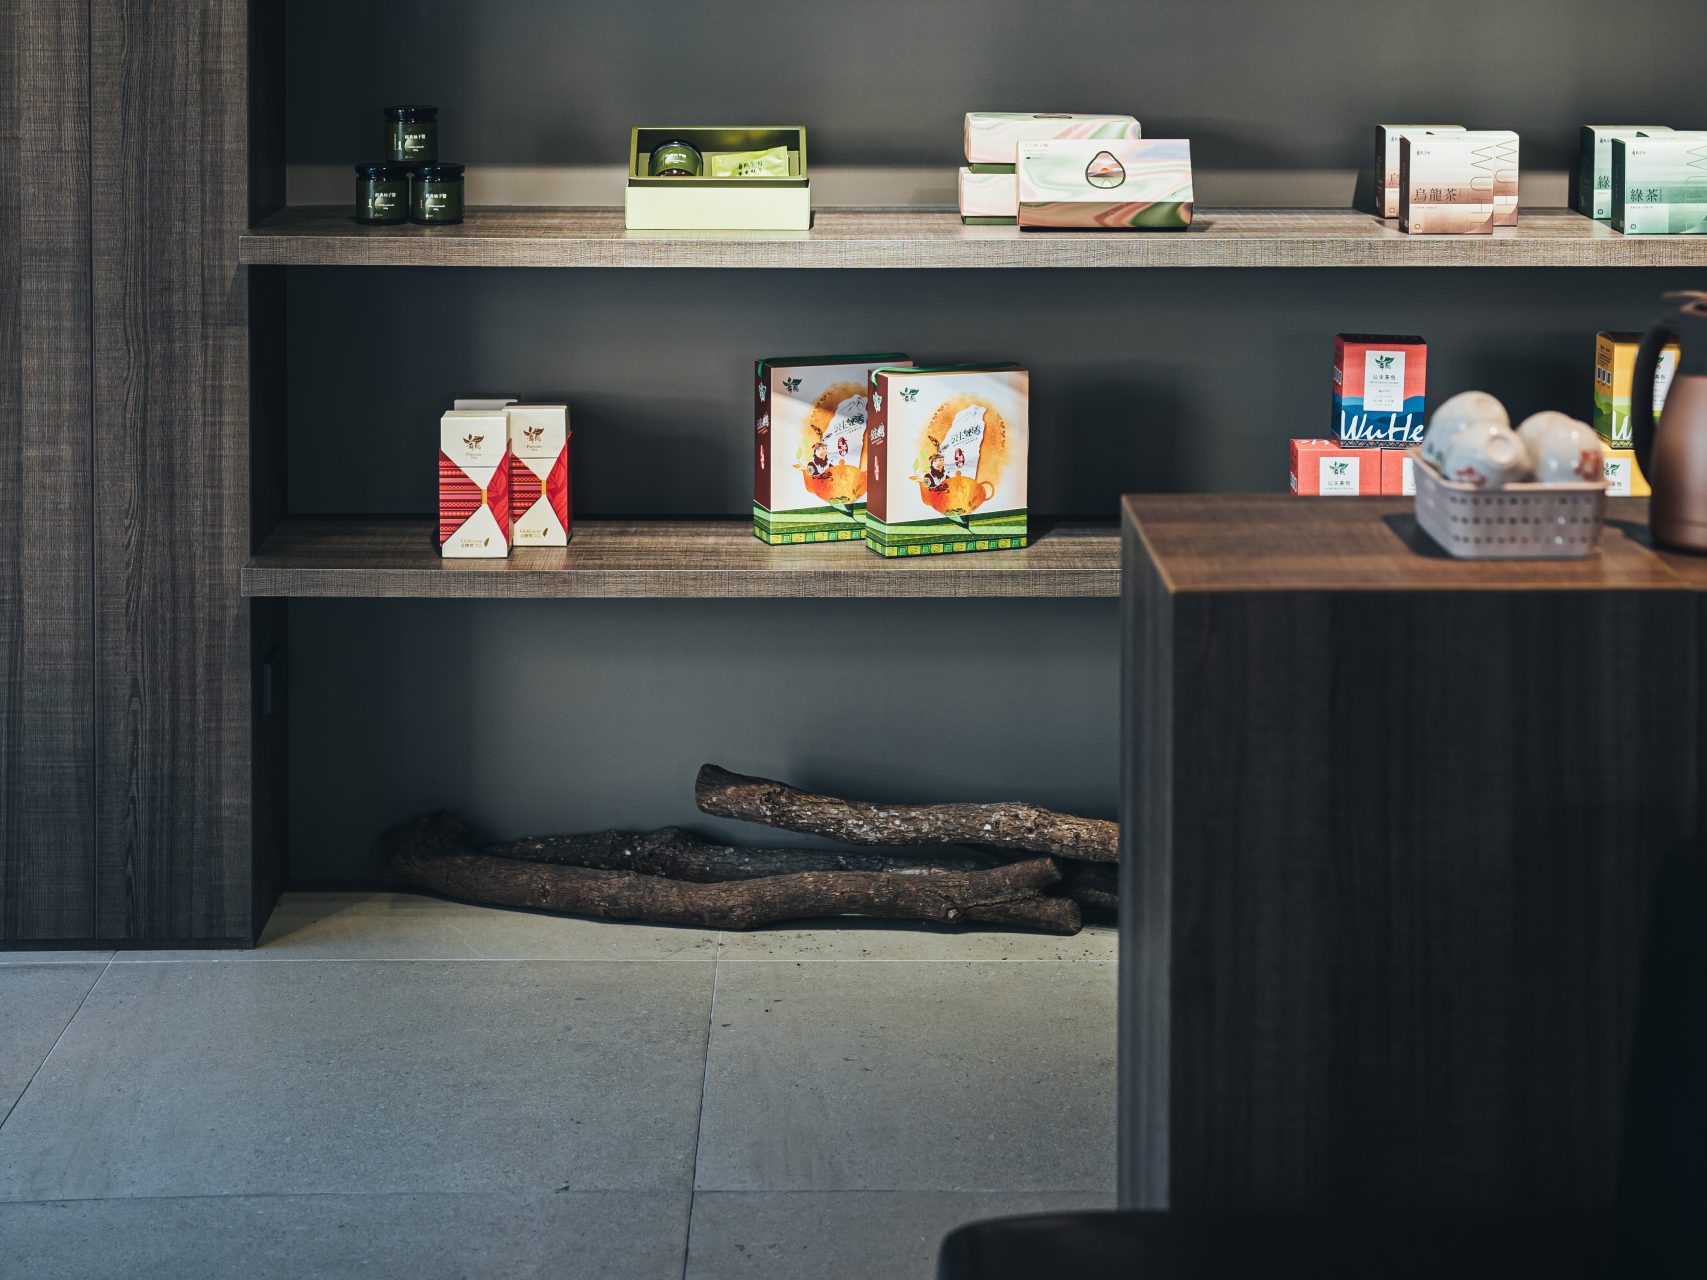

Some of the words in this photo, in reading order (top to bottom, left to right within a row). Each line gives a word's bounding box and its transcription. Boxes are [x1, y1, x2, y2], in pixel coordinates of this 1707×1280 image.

[1414, 187, 1457, 202] 烏龍茶
[1630, 188, 1659, 202] 綠茶
[1340, 409, 1425, 441] WuHe
